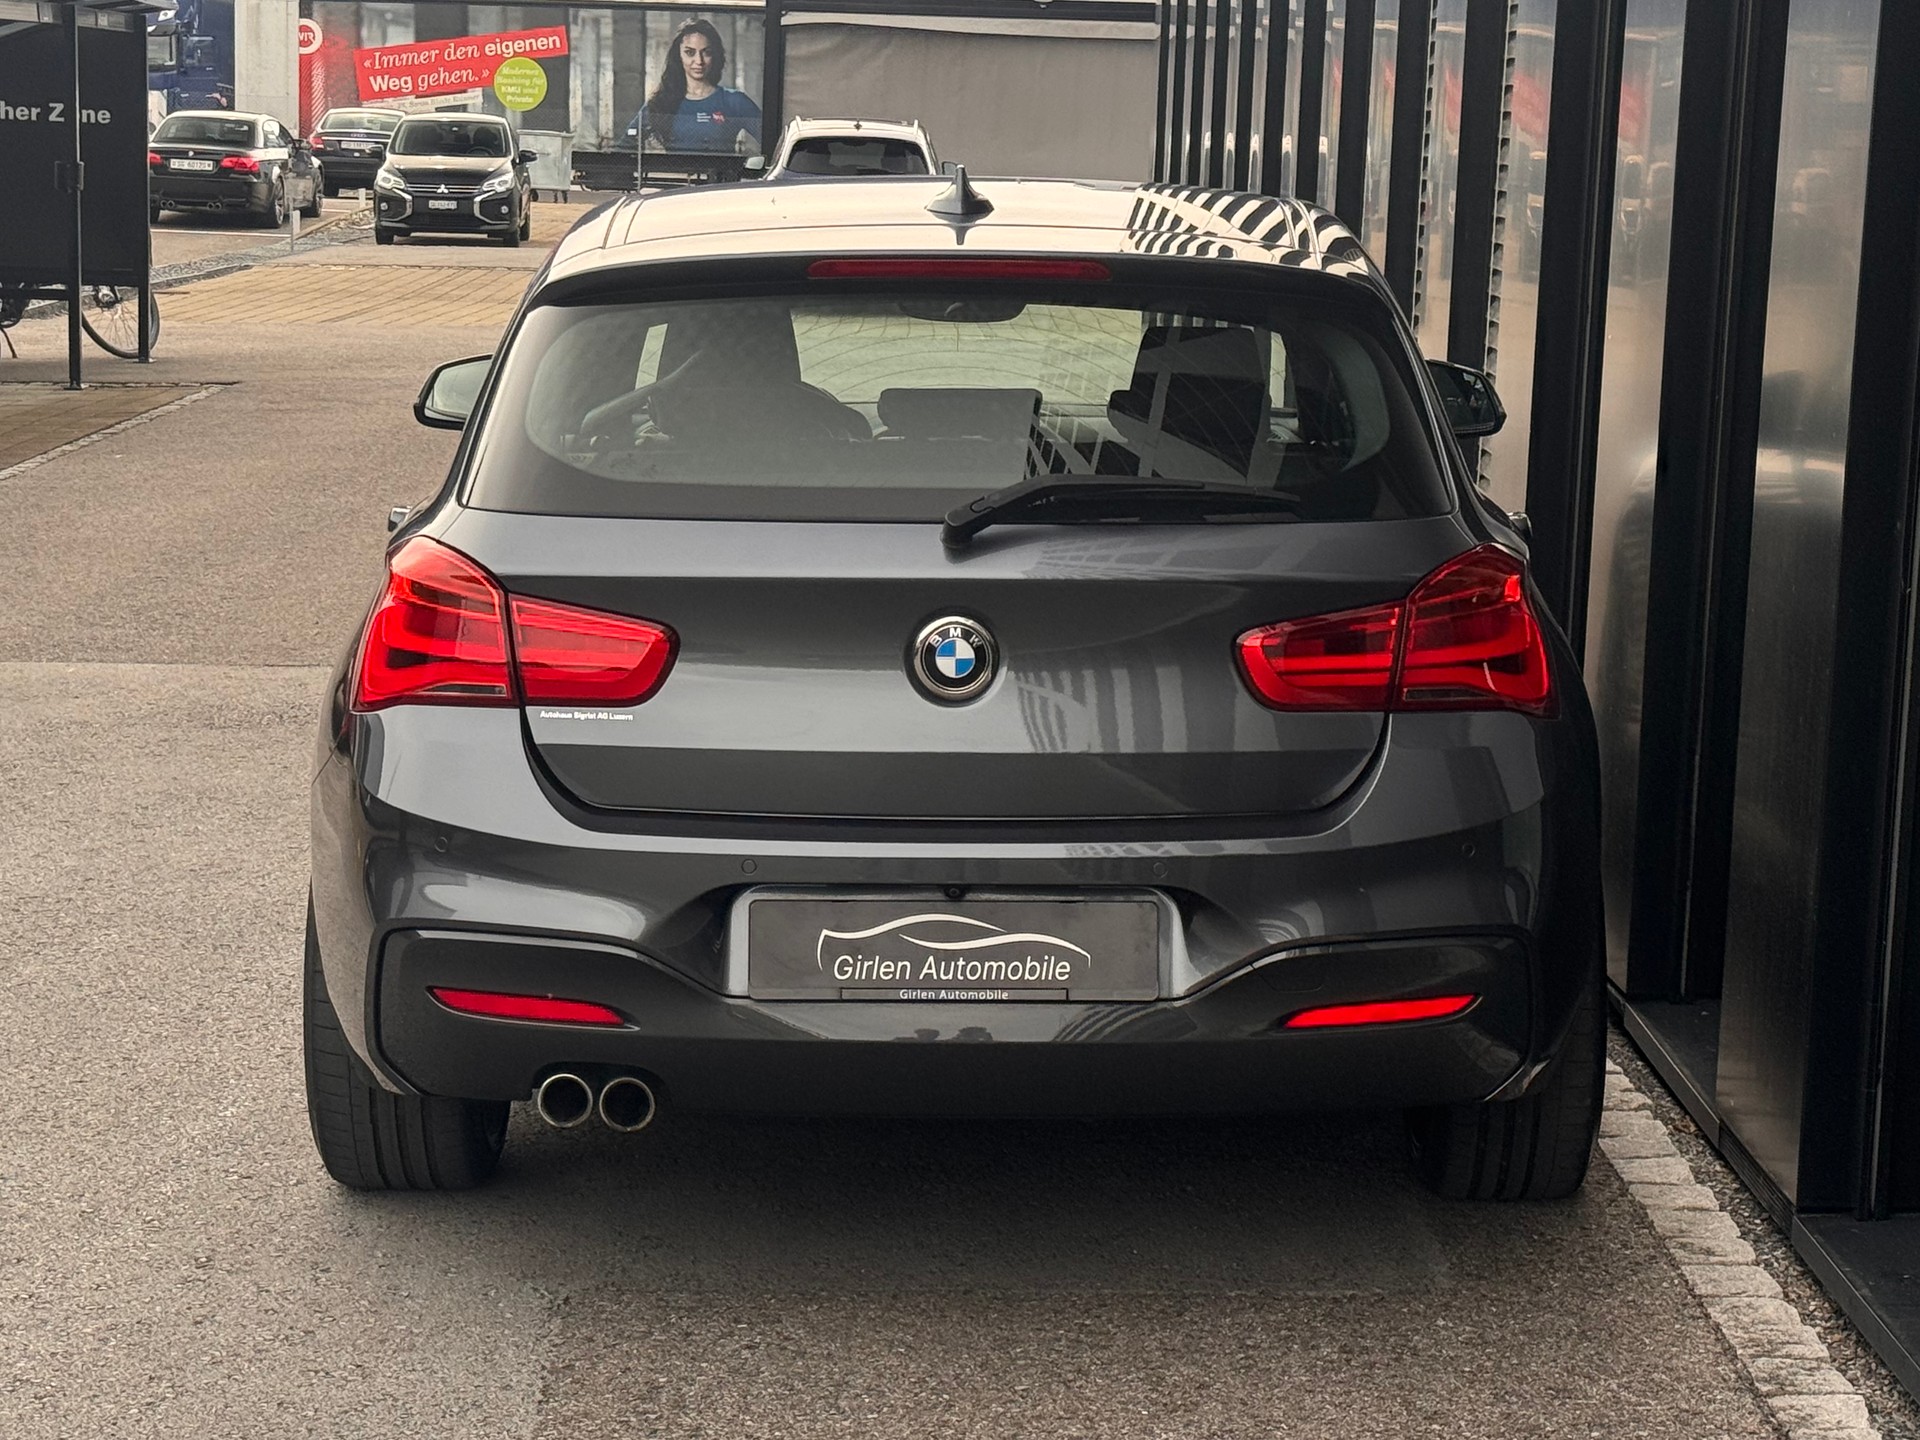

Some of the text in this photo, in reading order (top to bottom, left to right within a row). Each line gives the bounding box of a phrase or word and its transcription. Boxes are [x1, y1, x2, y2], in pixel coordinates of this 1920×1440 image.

[443, 43, 480, 61] den
[484, 35, 561, 58] eigenen
[369, 74, 413, 92] Weg
[48, 102, 111, 124] Zne
[929, 627, 983, 648] BMW
[540, 710, 634, 721] Autohaus Sigrist AG Luzern
[833, 954, 1071, 980] Girlen Automobile
[899, 988, 1009, 1000] Girlen Automobile
